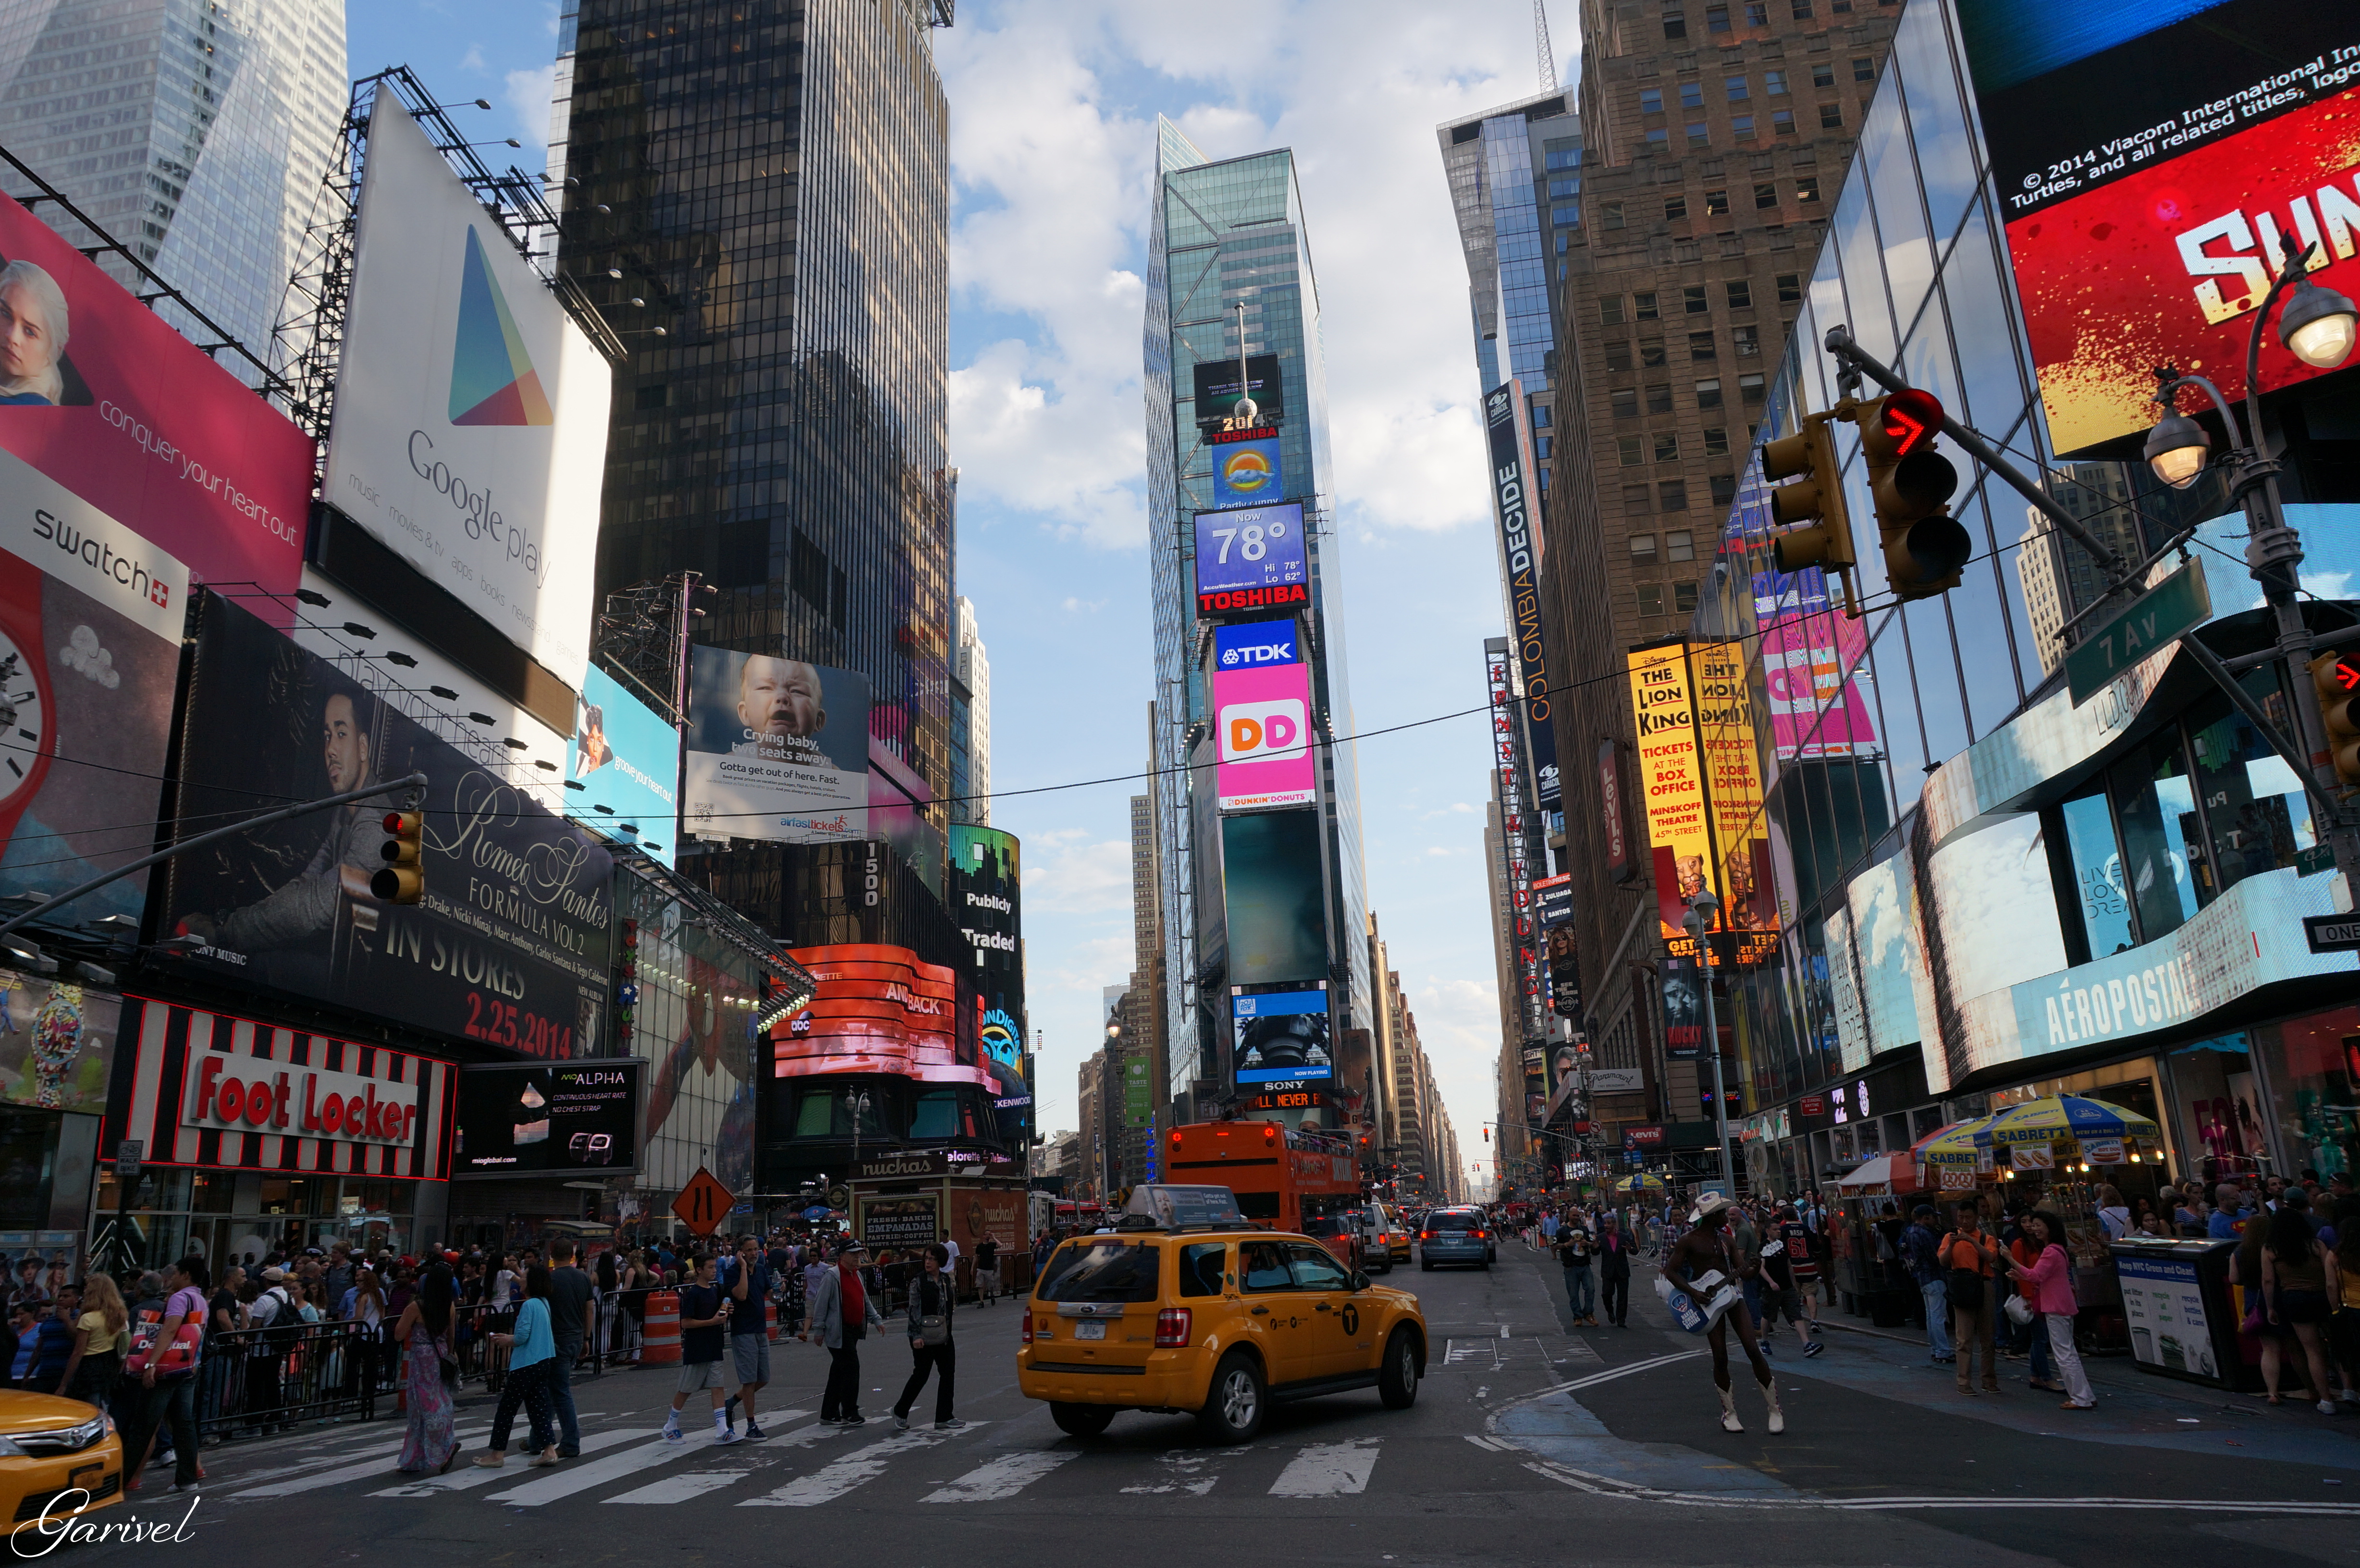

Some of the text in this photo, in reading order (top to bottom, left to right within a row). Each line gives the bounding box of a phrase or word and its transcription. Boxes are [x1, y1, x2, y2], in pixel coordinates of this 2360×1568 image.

[2048, 56, 2326, 180] 2014 Viacom International
[2011, 87, 2306, 209] Turtles, and all related titles,
[1491, 402, 1508, 418] CARACOL
[1223, 414, 1265, 431] 2014
[1212, 427, 1277, 443] TOSHIBA
[100, 400, 297, 547] conquer your heart out
[408, 429, 551, 590] Google play
[1236, 512, 1262, 523] Now
[1212, 522, 1286, 564] 78°
[33, 508, 149, 598] swatch
[349, 473, 551, 643] music movies & tv apps books newsstand
[1265, 561, 1300, 572] Hi 78°
[1204, 580, 1256, 591] AccuWeather.com
[1266, 572, 1301, 584] Lo 62°
[1200, 585, 1306, 612] TOSHIBA
[2099, 612, 2156, 669] 7 AV
[1238, 643, 1292, 662] TDK
[1641, 668, 1673, 684] THE
[1638, 687, 1682, 710] LION
[1231, 714, 1296, 751] DD
[1638, 711, 1690, 737] KING
[743, 728, 819, 751] Crying baby,
[456, 708, 508, 777] heart
[511, 757, 541, 797] out
[732, 741, 829, 766] two seats away.
[1642, 741, 1693, 759] TICKETS
[1654, 758, 1686, 770] AT THE
[615, 756, 672, 804] groove your heart out
[720, 761, 840, 785] Gotta get out of here. Fast.
[1656, 769, 1686, 782] BOX
[1650, 780, 1696, 796] OFFICE
[1271, 794, 1305, 802] DONUTS
[1650, 802, 1701, 817] MINSKOFF
[1656, 814, 1697, 827] THEATRE
[1674, 825, 1703, 835] STREET
[865, 842, 878, 906] 1500
[1545, 888, 1572, 901] ZULUAGA
[967, 893, 1011, 915] Publicly
[469, 877, 584, 956] FORMULA VOL 2
[1548, 907, 1571, 919] SANTOS
[1512, 861, 1538, 995] YOUNG
[428, 896, 452, 919] Drake,
[453, 907, 472, 927] Nicki
[472, 915, 492, 938] Minaj,
[493, 924, 510, 942] Marc
[510, 931, 535, 957] Anthony,
[535, 944, 552, 962] Carlos
[552, 952, 572, 972] Santana
[572, 962, 577, 974] &
[577, 963, 588, 980] Tego
[588, 968, 608, 987] Calderon
[961, 928, 1015, 952] Traded
[1669, 939, 1695, 952] GET
[217, 948, 247, 966] MUSIC
[386, 915, 525, 1000] IN STORES
[578, 985, 603, 1003] NEW ALBUM
[886, 982, 941, 1015] AND BACK
[464, 992, 572, 1060] 2.25.2014
[791, 1020, 810, 1031] abc
[1667, 1025, 1702, 1044] ROCKY
[576, 1072, 625, 1085] ALPHA
[1265, 1081, 1304, 1090] SONY
[1590, 1072, 1634, 1088] Paramount
[196, 1056, 417, 1141] Foot Locker
[553, 1093, 591, 1102] CONTINUOUS
[1278, 1093, 1308, 1107] NEVER
[1997, 1127, 2067, 1144] SABRETT
[2084, 1140, 2119, 1153] SABRETT
[472, 1157, 517, 1165] mioglobal.com
[862, 1158, 932, 1176] nuchas
[1842, 1185, 1861, 1197] NUTS
[1866, 1183, 1887, 1195] NUTS
[985, 1203, 1015, 1223] nuchas
[1128, 1216, 1145, 1225] 3H16
[867, 1222, 934, 1233] EMPANADAS
[1787, 1237, 1808, 1258] 61
[2118, 1261, 2195, 1276] Keep NYC Green and Clean!
[2132, 1287, 2143, 1296] litter
[2181, 1295, 2199, 1303] recycle
[1681, 1309, 1694, 1319] NAKED
[1682, 1311, 1698, 1324] COWBOY
[2132, 1310, 2145, 1318] place
[2184, 1306, 2202, 1315] bottles
[1345, 1310, 1354, 1332] T
[1685, 1316, 1701, 1330] OYSTERS
